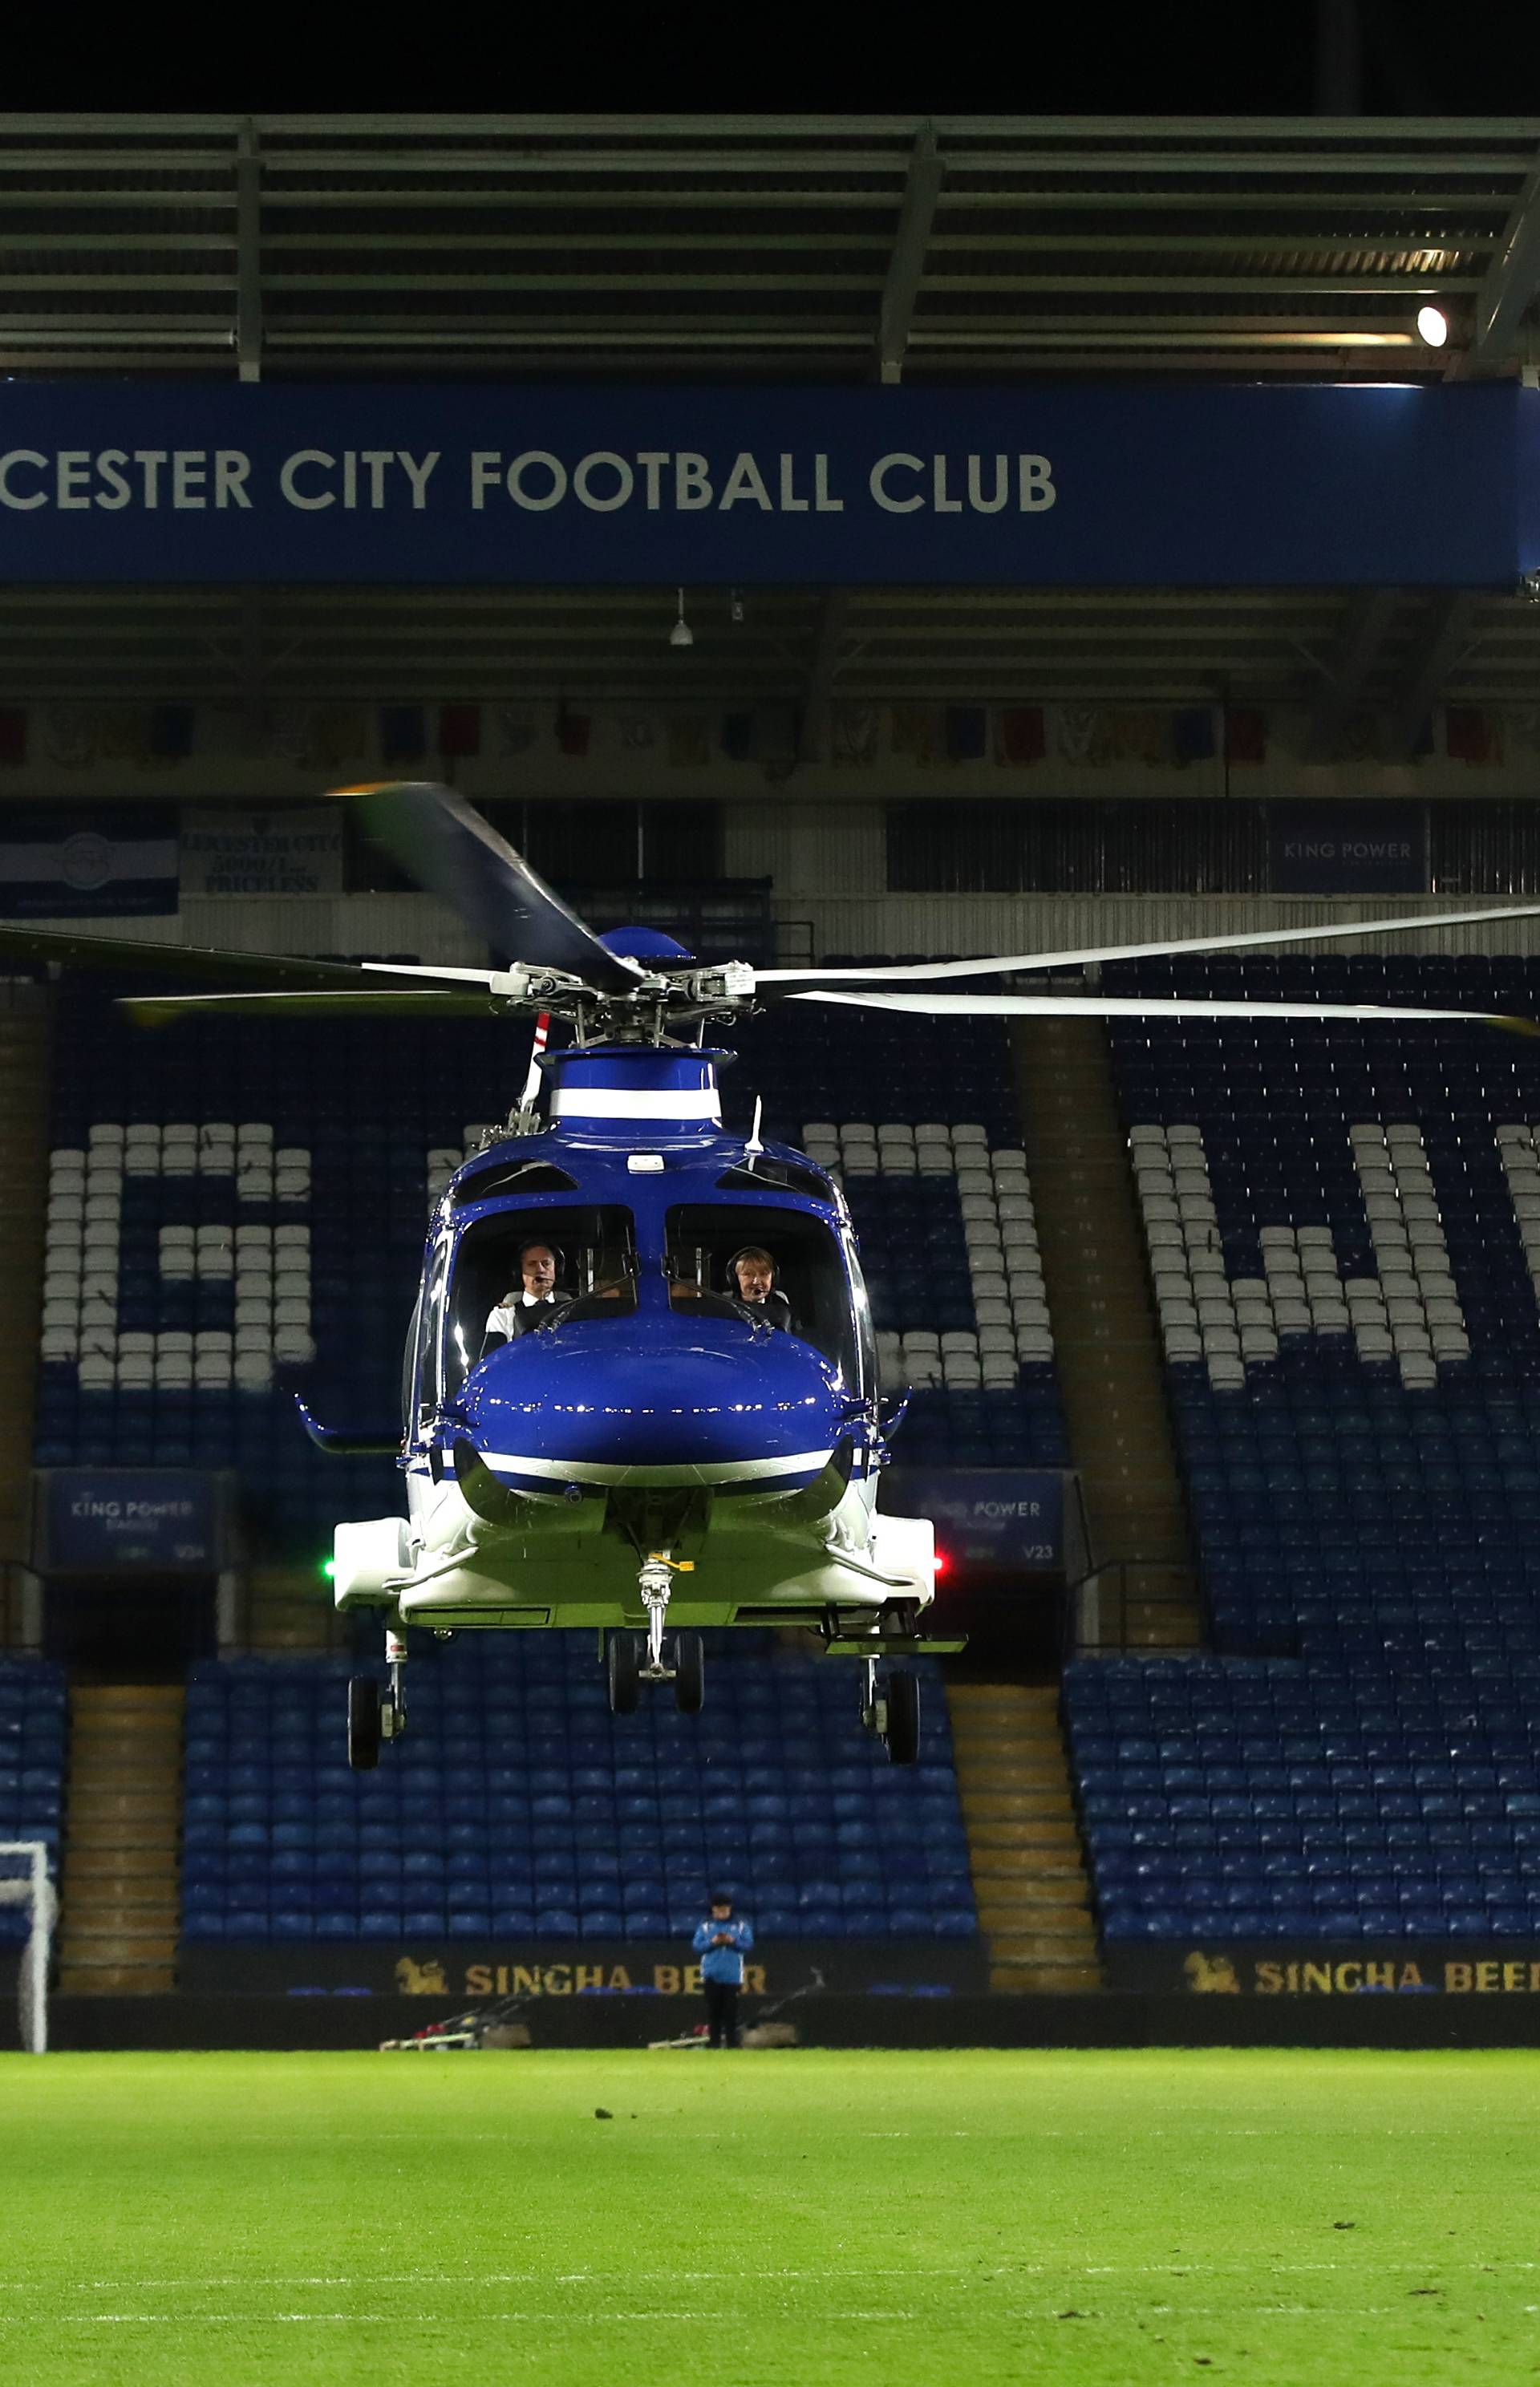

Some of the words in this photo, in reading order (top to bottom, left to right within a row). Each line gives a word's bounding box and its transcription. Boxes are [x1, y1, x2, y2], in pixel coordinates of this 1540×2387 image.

[1, 448, 253, 512] CESTER
[279, 448, 442, 512] CITY
[470, 449, 845, 513] FOOTBALL
[868, 452, 1058, 514] CLUB
[1284, 842, 1336, 858] KING
[1342, 842, 1412, 858] POWER
[71, 1500, 121, 1518] KING
[973, 1500, 1042, 1518] POWER
[1023, 1545, 1054, 1560] V23
[465, 1964, 632, 1996] SINGHA
[653, 1965, 767, 1996] BER
